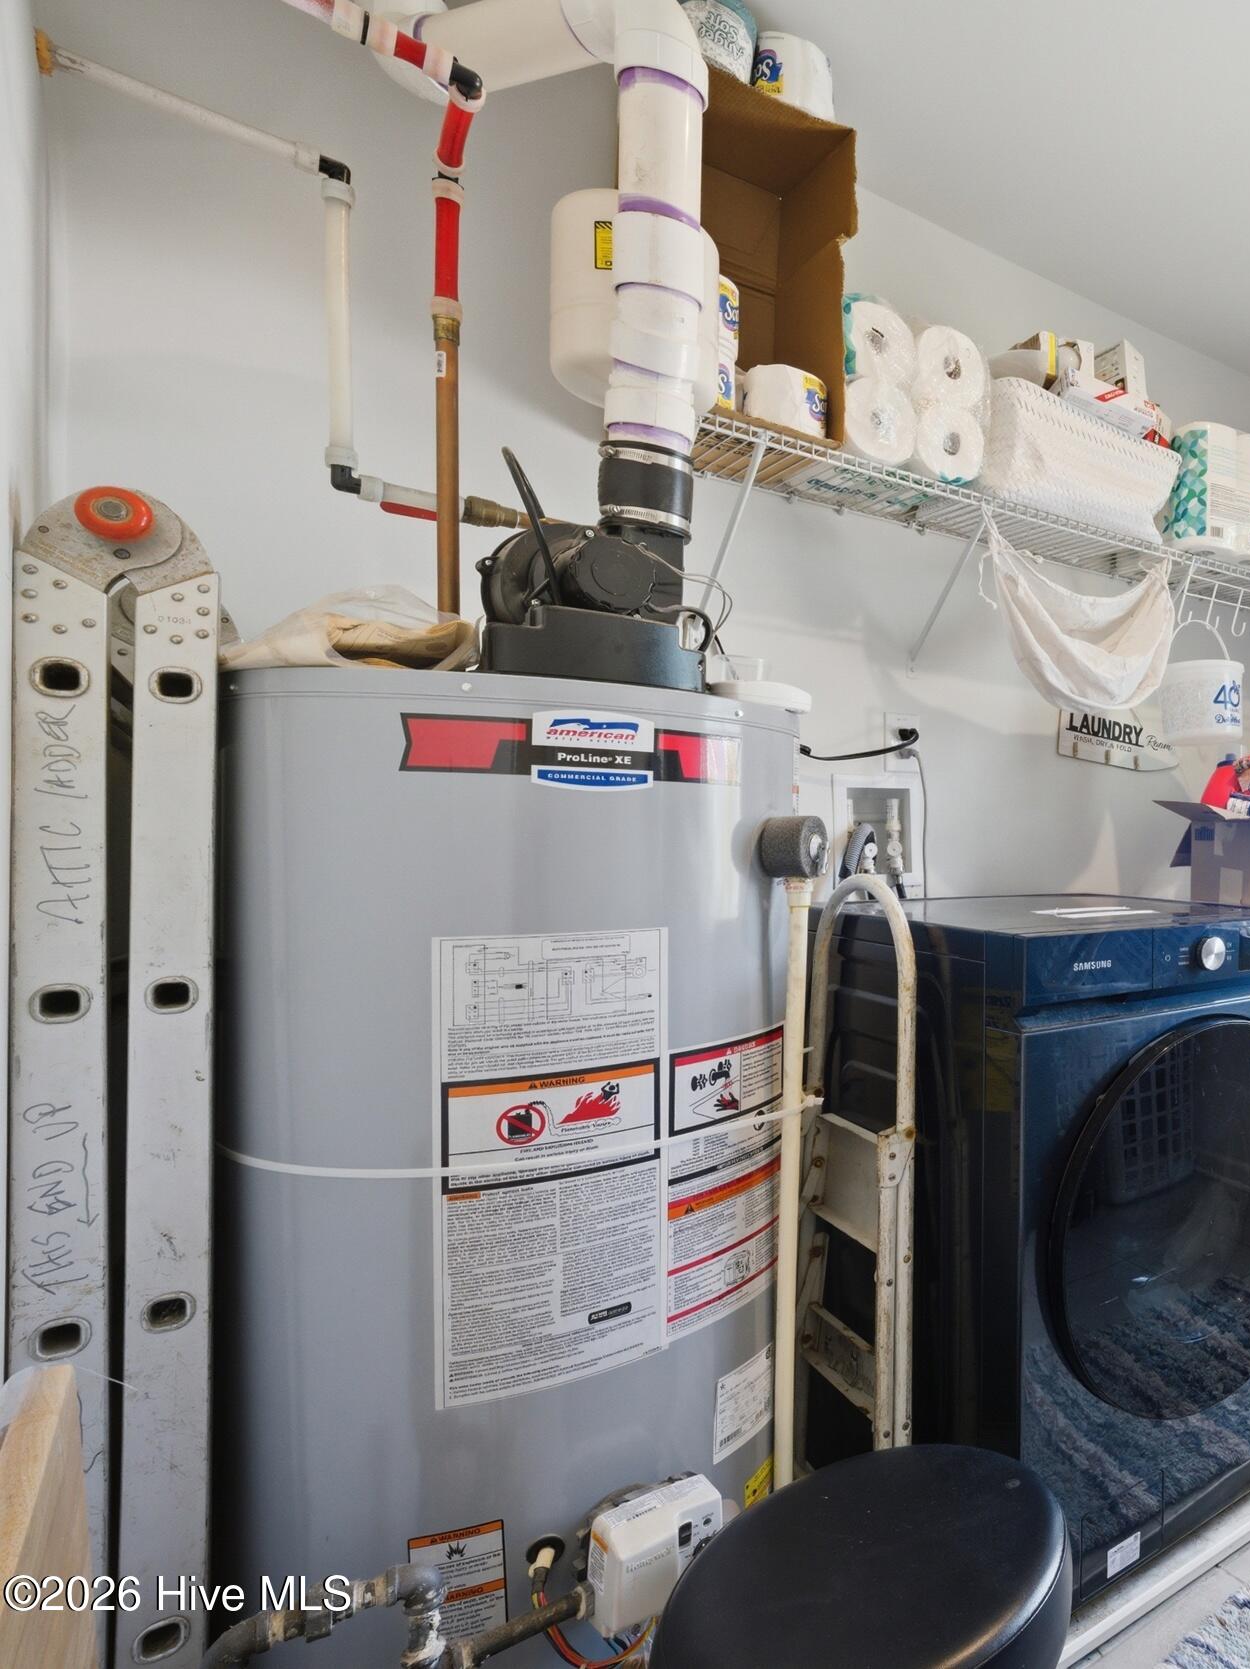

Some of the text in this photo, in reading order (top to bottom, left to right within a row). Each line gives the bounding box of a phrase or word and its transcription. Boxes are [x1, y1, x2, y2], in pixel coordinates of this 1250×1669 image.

[698, 22, 744, 60] Angel
[546, 728, 635, 740] american
[1067, 712, 1144, 747] LAUNDRY
[614, 755, 632, 765] XE
[547, 772, 637, 783] COMMERCIAL GRADE
[36, 821, 92, 925] ATTIC
[1073, 959, 1112, 972] SAMSUNG
[539, 1076, 585, 1090] WARNING
[22, 1103, 89, 1296] THIS END UP
[437, 1527, 481, 1542] WARNING
[447, 1586, 484, 1601] ARNING
